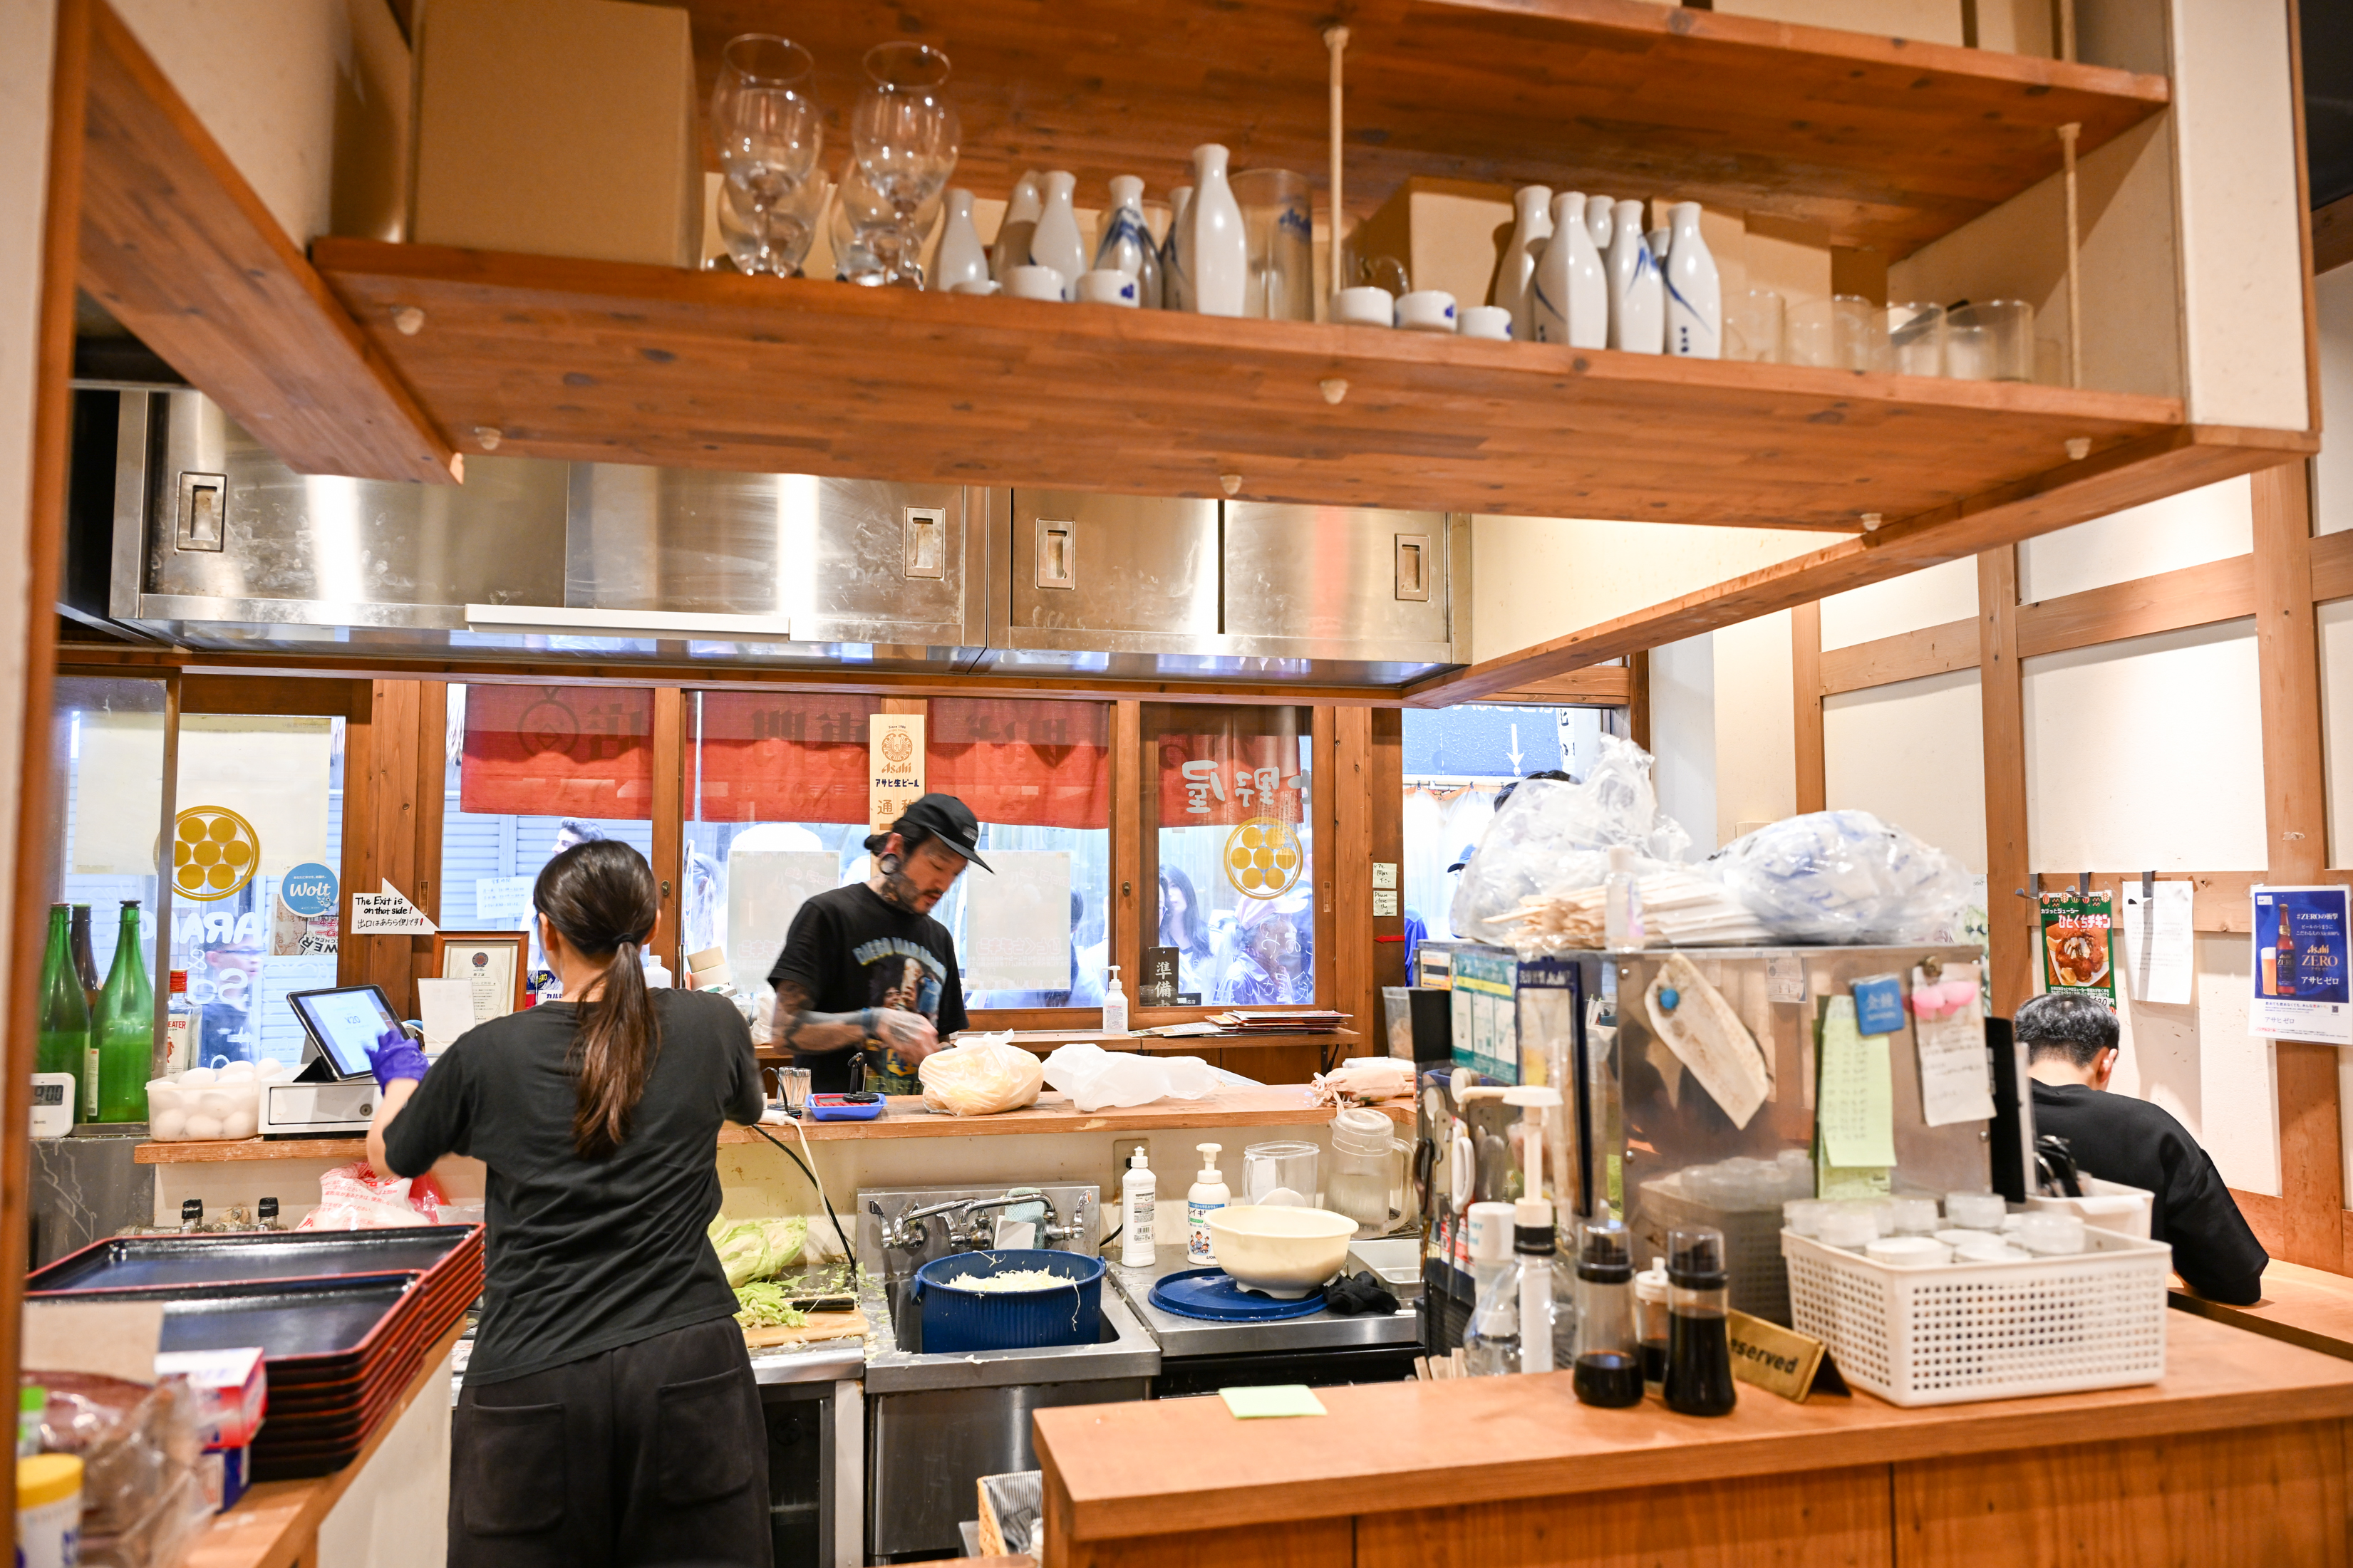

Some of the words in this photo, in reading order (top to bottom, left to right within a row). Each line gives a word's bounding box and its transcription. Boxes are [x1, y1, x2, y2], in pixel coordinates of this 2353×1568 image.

[881, 762, 911, 774] Asahi
[875, 779, 919, 787] アサヒ生ビール
[290, 882, 331, 897] Wolt
[374, 896, 392, 905] Exit
[2058, 913, 2111, 929] ひとくちチキン
[2307, 945, 2329, 954] Asahi
[2301, 955, 2339, 967] ZERO
[345, 1015, 361, 1024] ¥20
[299, 1217, 314, 1228] JA
